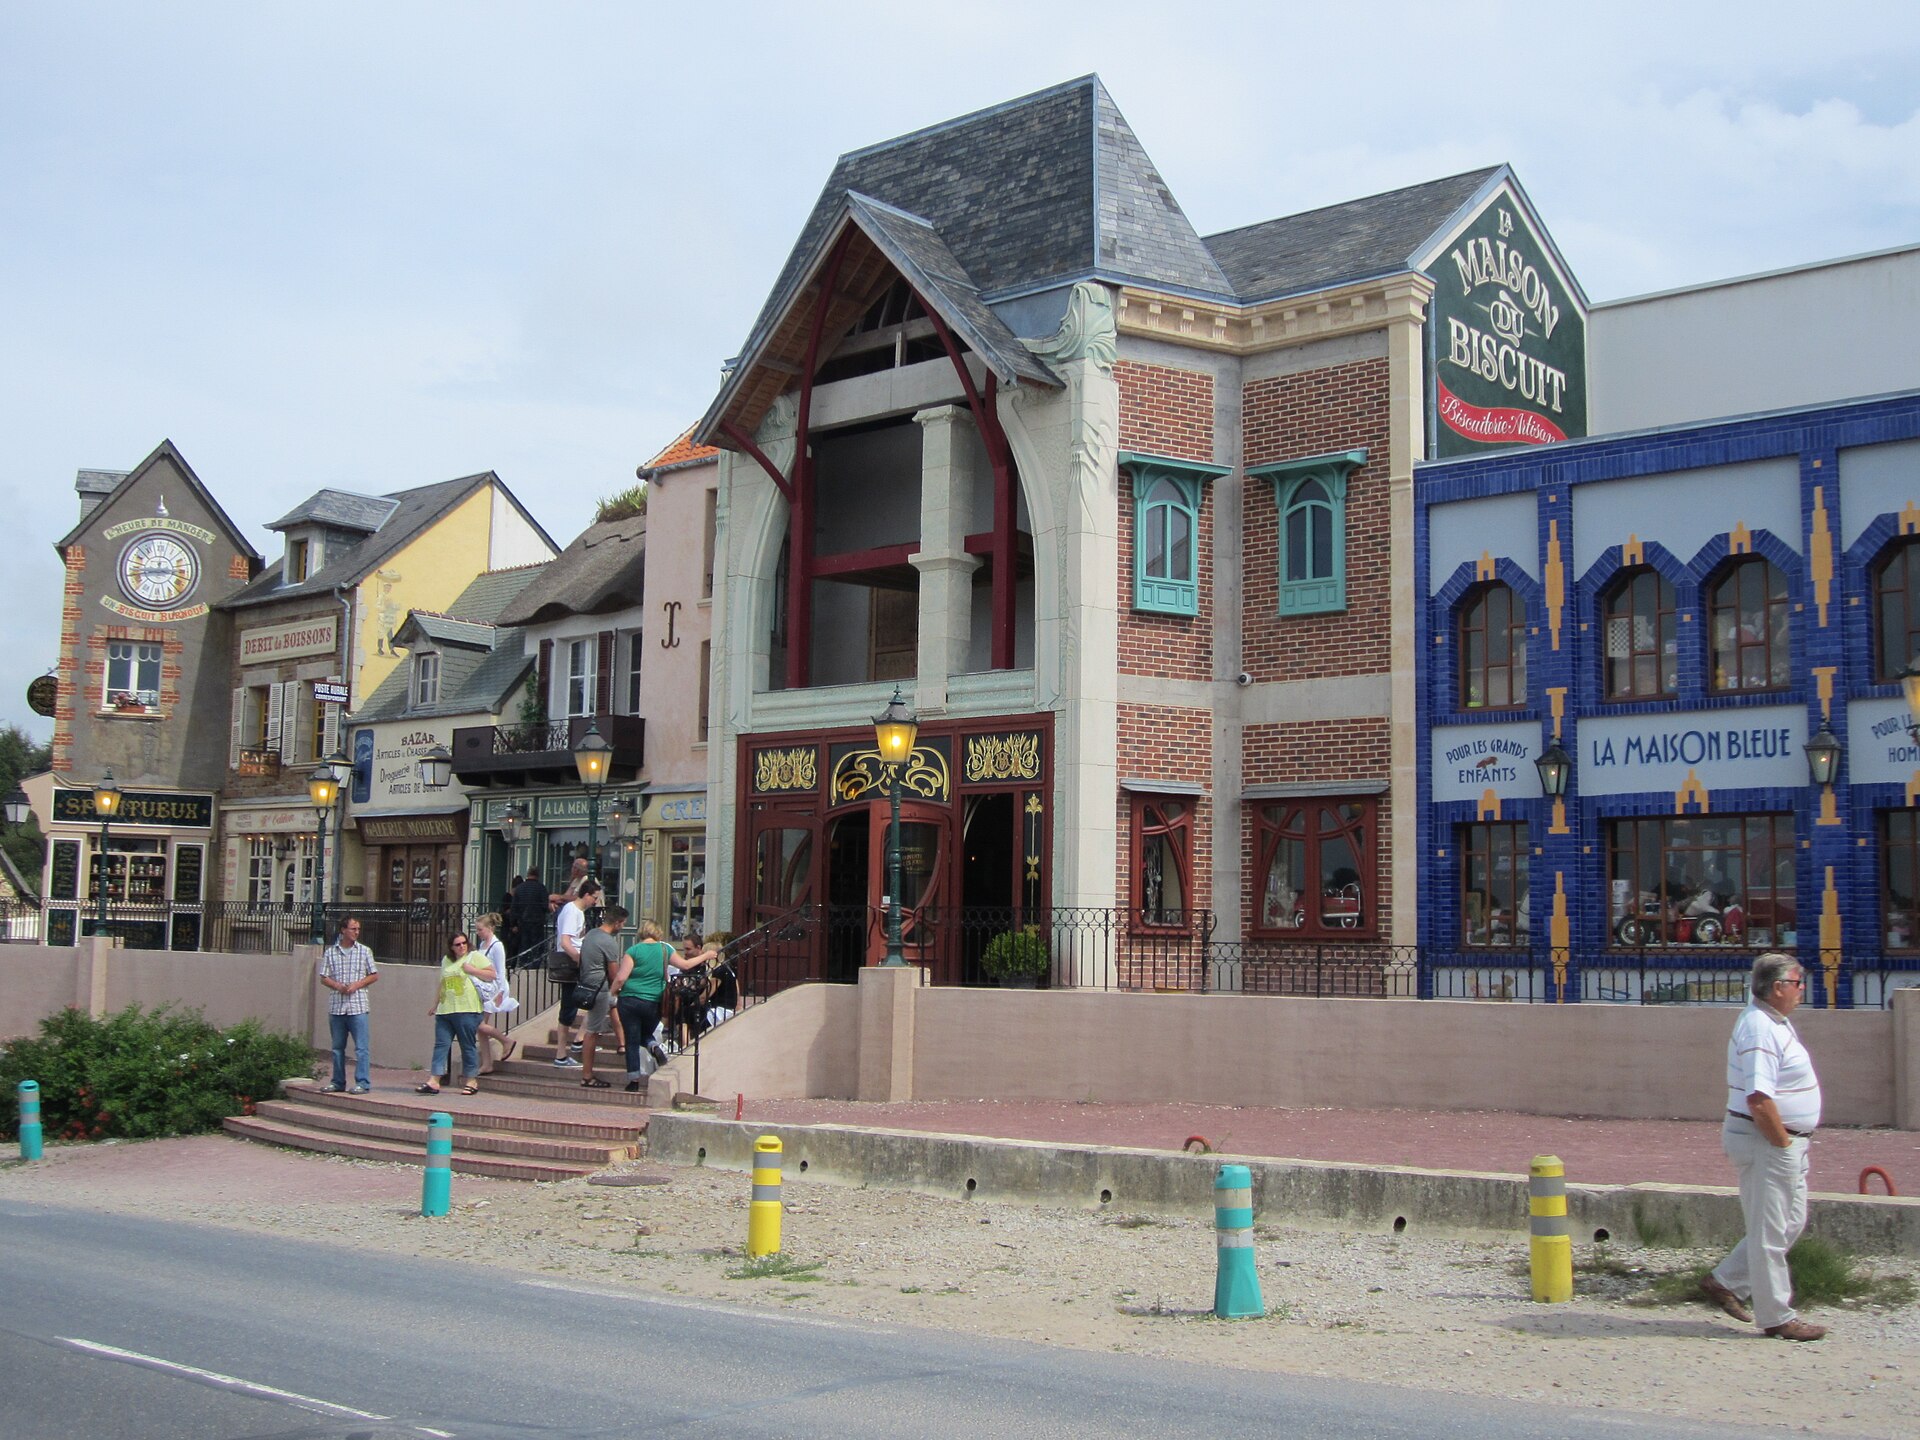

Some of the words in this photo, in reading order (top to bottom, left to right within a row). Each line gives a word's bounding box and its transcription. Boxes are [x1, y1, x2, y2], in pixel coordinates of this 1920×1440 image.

[1498, 207, 1513, 237] LA
[1451, 236, 1559, 340] MAISON
[1491, 290, 1525, 348] DU
[1447, 316, 1566, 413] BISCUIT
[1442, 396, 1508, 435] Biscuiterie
[118, 603, 157, 620] BISCUIT
[245, 636, 274, 655] DEBIT
[283, 627, 332, 649] BOISSONS
[314, 683, 330, 694] POSTE
[401, 731, 435, 747] BAZAR
[1871, 716, 1902, 740] POUR
[375, 748, 401, 760] ARTICLES
[1445, 744, 1471, 764] POUR
[1473, 740, 1487, 755] LES
[1490, 738, 1528, 759] GRANDS
[1593, 737, 1616, 766] LA
[1624, 730, 1721, 765] MAISON
[1727, 728, 1791, 760] BLEUE
[1888, 746, 1920, 763] HOM
[1458, 767, 1517, 784] ENFANTS
[413, 783, 421, 794] DE
[65, 798, 199, 819] SPITUEUX
[553, 801, 565, 815] LA
[660, 797, 707, 820] CRE
[365, 821, 405, 837] GALERIE
[407, 820, 456, 837] MODERNE
